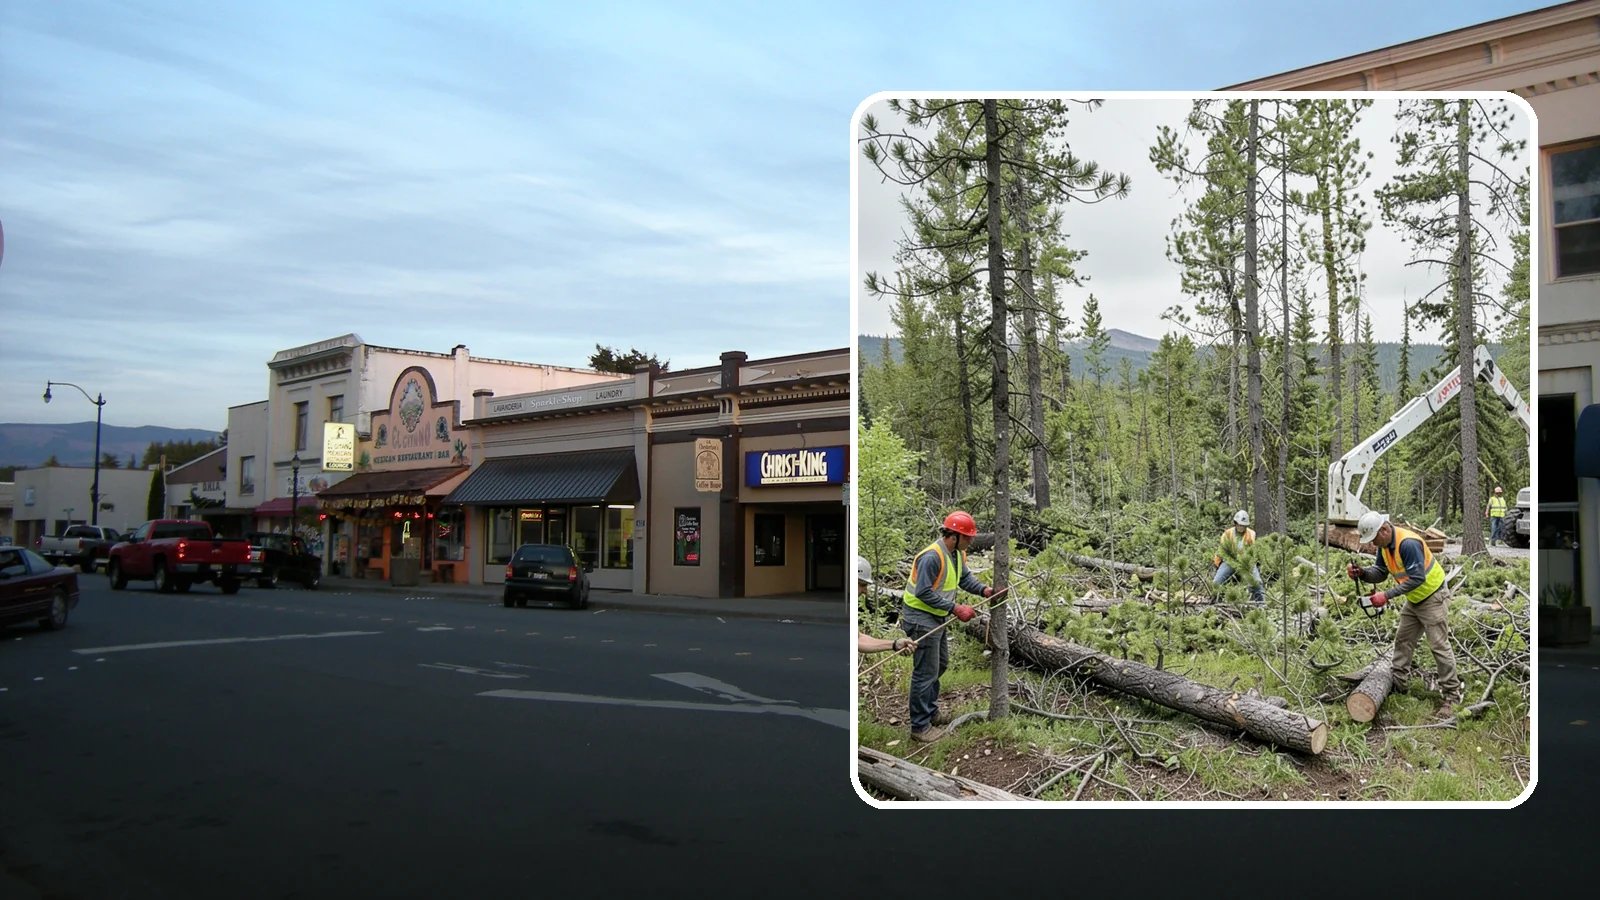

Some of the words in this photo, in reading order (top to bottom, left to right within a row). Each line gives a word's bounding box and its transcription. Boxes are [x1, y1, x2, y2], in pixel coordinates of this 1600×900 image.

[530, 397, 561, 409] Sparkle
[562, 394, 583, 405] Shop
[595, 389, 623, 400] LAUNDRY
[493, 402, 522, 413] LAVANDERIA
[373, 455, 396, 464] MEXICAN
[397, 452, 434, 462] RESTAURANT
[437, 450, 450, 459] BAR
[760, 452, 797, 478] CHRIST
[799, 450, 827, 476] KING
